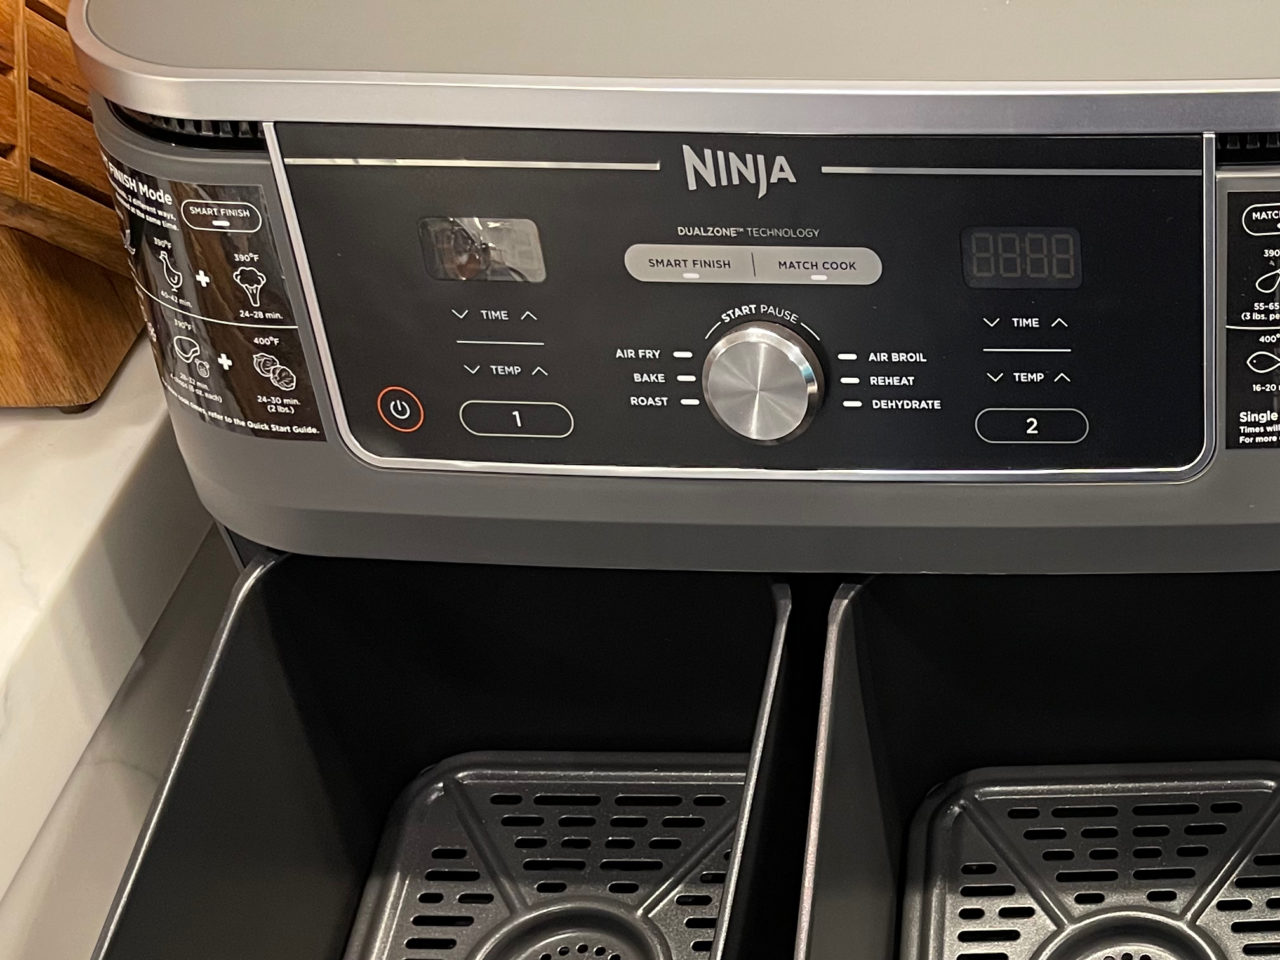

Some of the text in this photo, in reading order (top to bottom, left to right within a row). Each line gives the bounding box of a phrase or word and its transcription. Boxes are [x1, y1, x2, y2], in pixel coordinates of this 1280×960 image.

[682, 144, 797, 199] NINJA
[138, 181, 173, 205] Mode
[189, 206, 251, 218] SMART FINISH
[747, 227, 820, 238] TECHNOLOGY
[233, 252, 259, 262] 390°F
[648, 258, 731, 270] SMART FINISH
[778, 260, 857, 271] MATCH COOK
[1253, 302, 1280, 311] 55-65
[480, 310, 509, 320] TIME
[721, 304, 800, 324] START PAUSE
[1241, 312, 1251, 321] (3
[1252, 312, 1268, 321] lbs.
[1012, 318, 1040, 328] TIME
[253, 336, 280, 346] 400°F
[615, 349, 661, 359] AIR FRY
[868, 352, 927, 363] AIR BROIL
[490, 365, 522, 376] TEMP
[633, 373, 666, 383] BAKE
[869, 376, 915, 387] REHEAT
[1013, 372, 1045, 383] TEMP
[1252, 383, 1277, 392] 16-20
[629, 396, 669, 407] ROAST
[872, 399, 942, 410] DEHYDRATE
[512, 410, 522, 428] 1
[1239, 410, 1279, 425] Single
[224, 415, 233, 424] to
[233, 418, 246, 427] the
[246, 420, 270, 432] Quick
[270, 423, 292, 433] Start
[292, 425, 320, 435] Guide.
[1026, 417, 1039, 434] 2
[1239, 425, 1265, 434] Times
[1266, 424, 1280, 432] will
[1239, 436, 1254, 444] For
[1255, 434, 1278, 443] more
